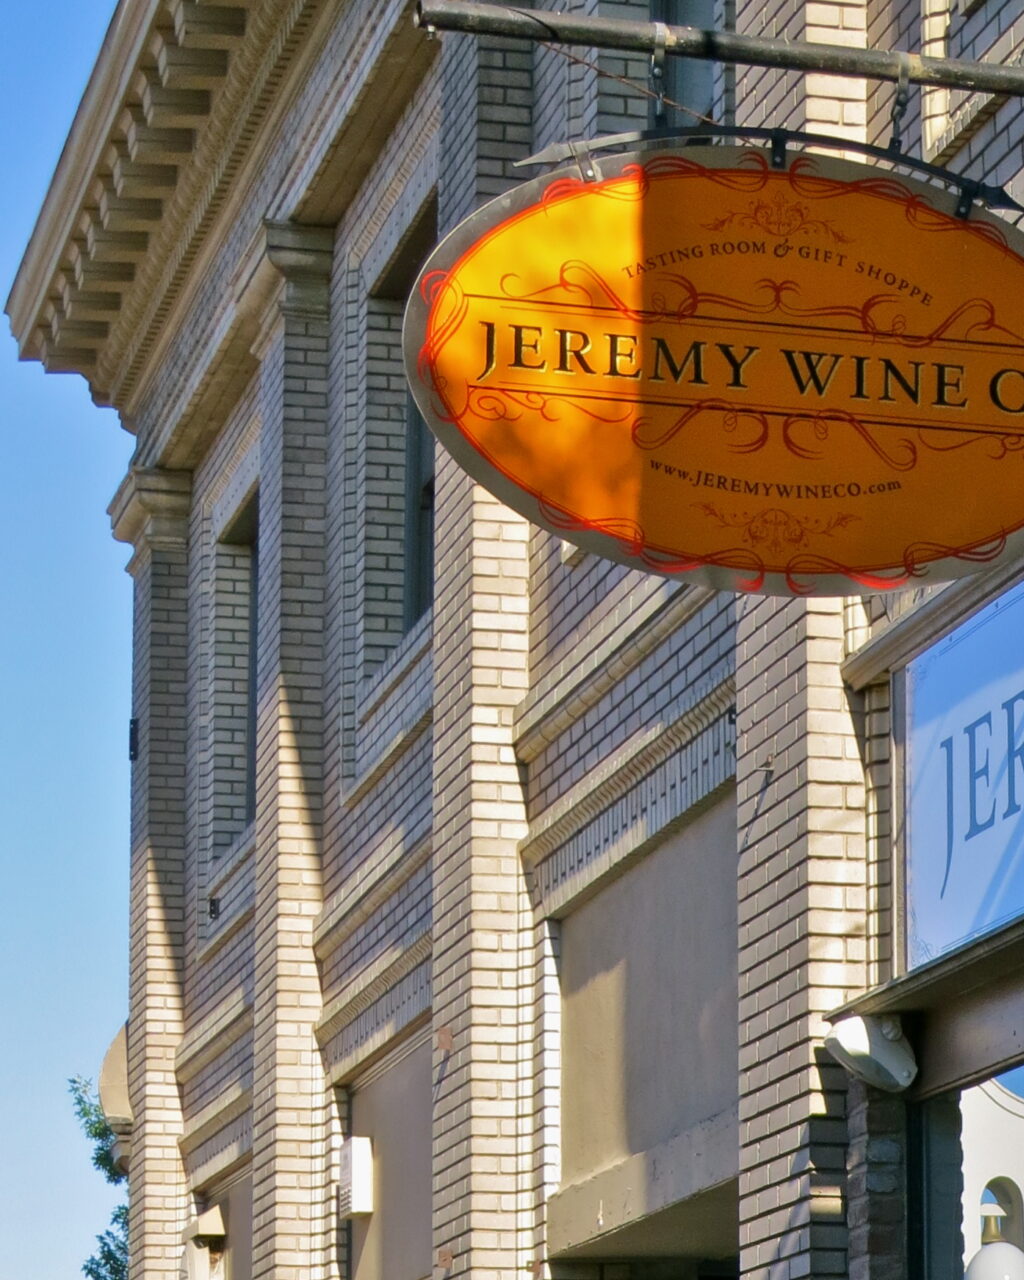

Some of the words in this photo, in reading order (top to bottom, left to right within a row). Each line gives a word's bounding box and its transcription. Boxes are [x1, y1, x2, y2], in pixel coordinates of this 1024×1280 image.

[622, 245, 704, 279] TASTING
[710, 240, 767, 257] ROOM
[773, 238, 794, 258] &
[798, 245, 847, 268] GIFT
[855, 260, 934, 306] SHOPPE
[476, 321, 761, 390] JEREMY
[780, 348, 968, 408] WINE
[650, 459, 902, 499] www.JEREMYWINECO.com
